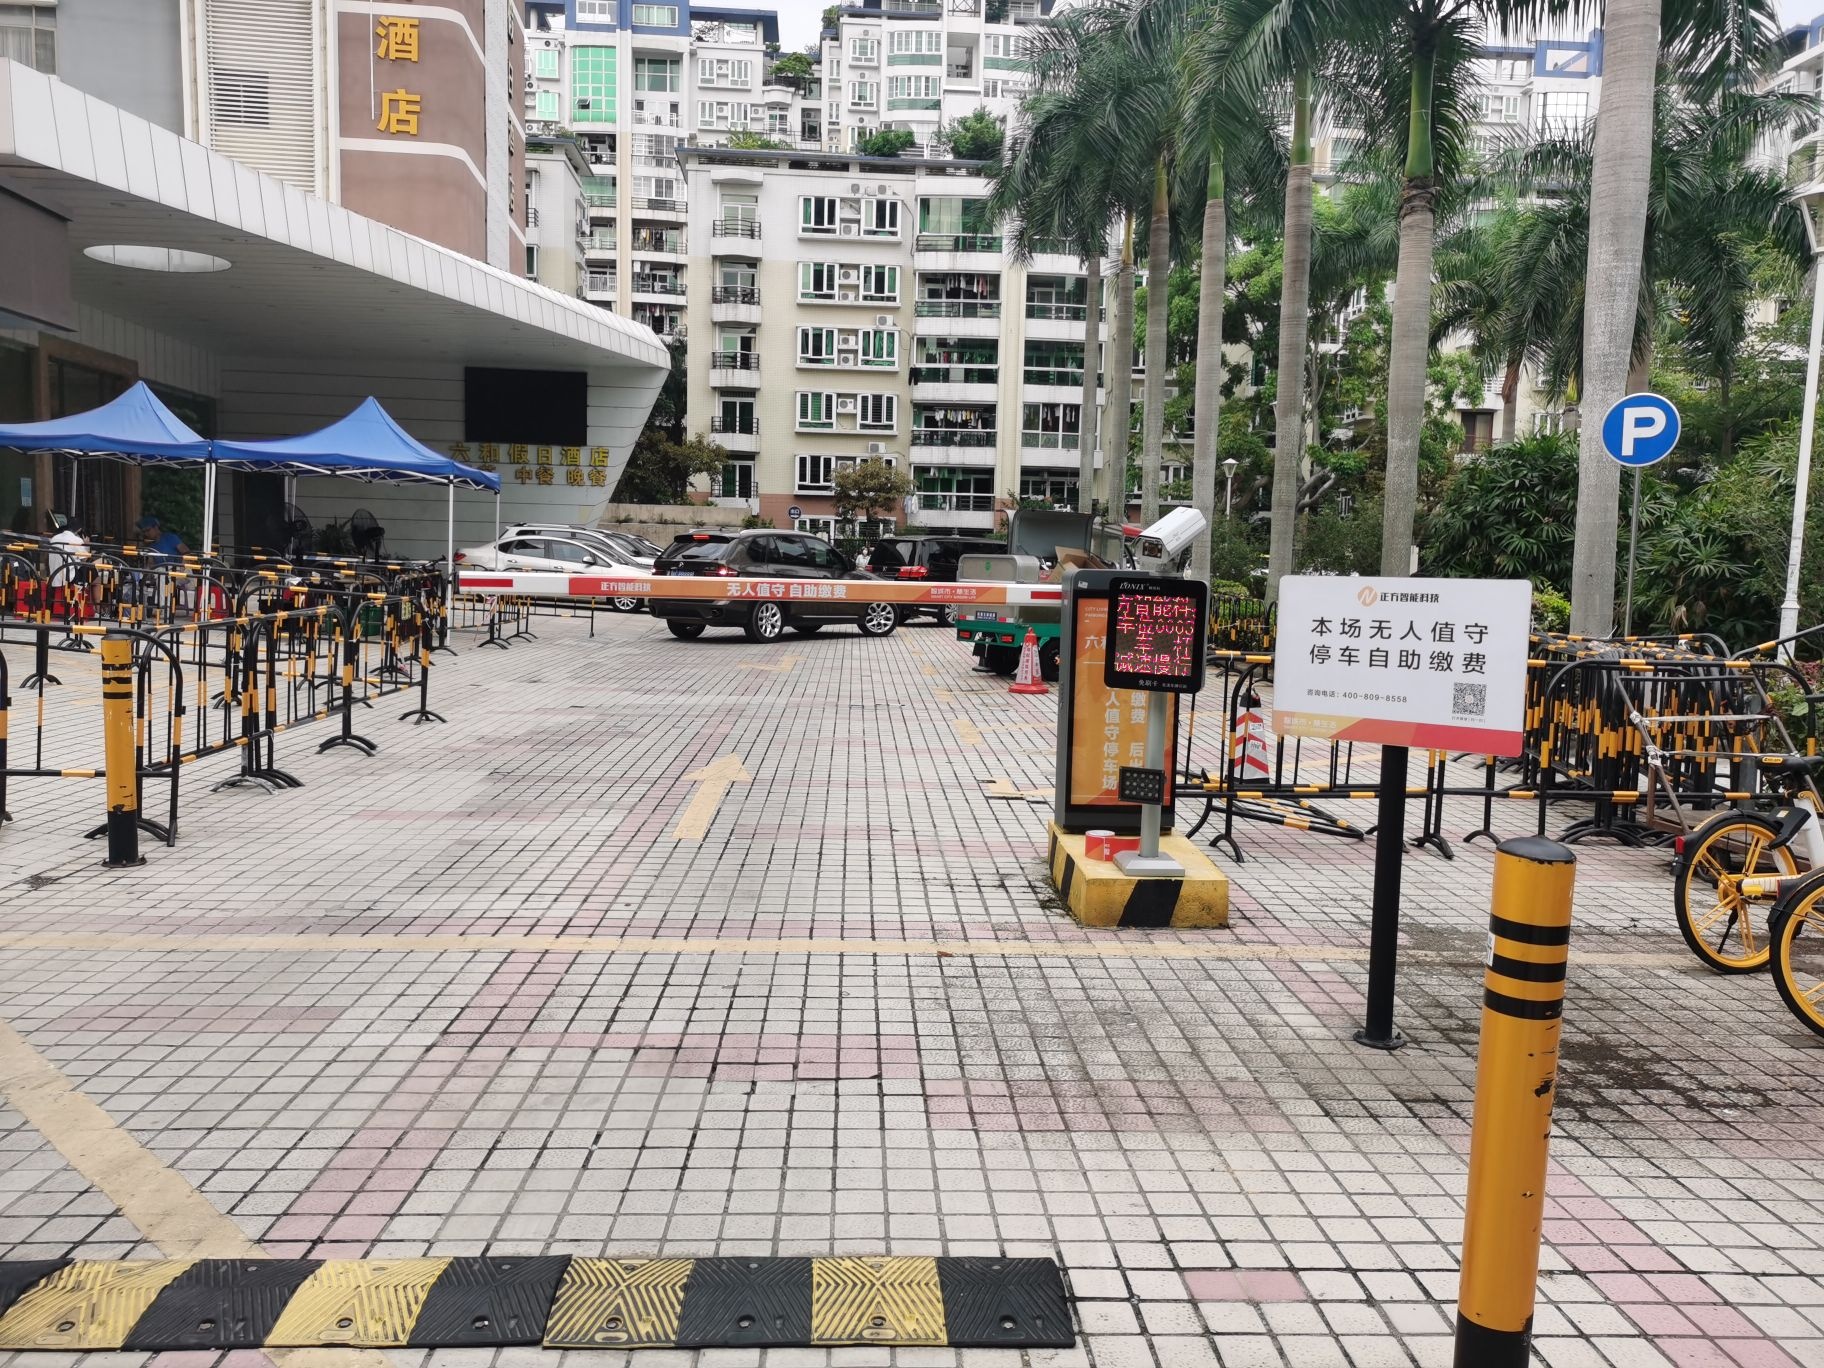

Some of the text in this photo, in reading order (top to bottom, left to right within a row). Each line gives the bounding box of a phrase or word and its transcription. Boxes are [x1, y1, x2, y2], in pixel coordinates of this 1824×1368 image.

[375, 15, 421, 135] 酒店
[1622, 407, 1666, 456] P
[449, 441, 610, 467] 六和假日酒店
[516, 466, 555, 486] 中餐
[567, 468, 608, 487] 晚餐
[727, 582, 847, 599] 无人值守 自助缴费
[1379, 592, 1440, 604] 正方智能科技
[1310, 616, 1489, 645] 本场无人值守
[1309, 643, 1487, 674] 停车自助缴费
[1102, 687, 1121, 790] 人值守停车场
